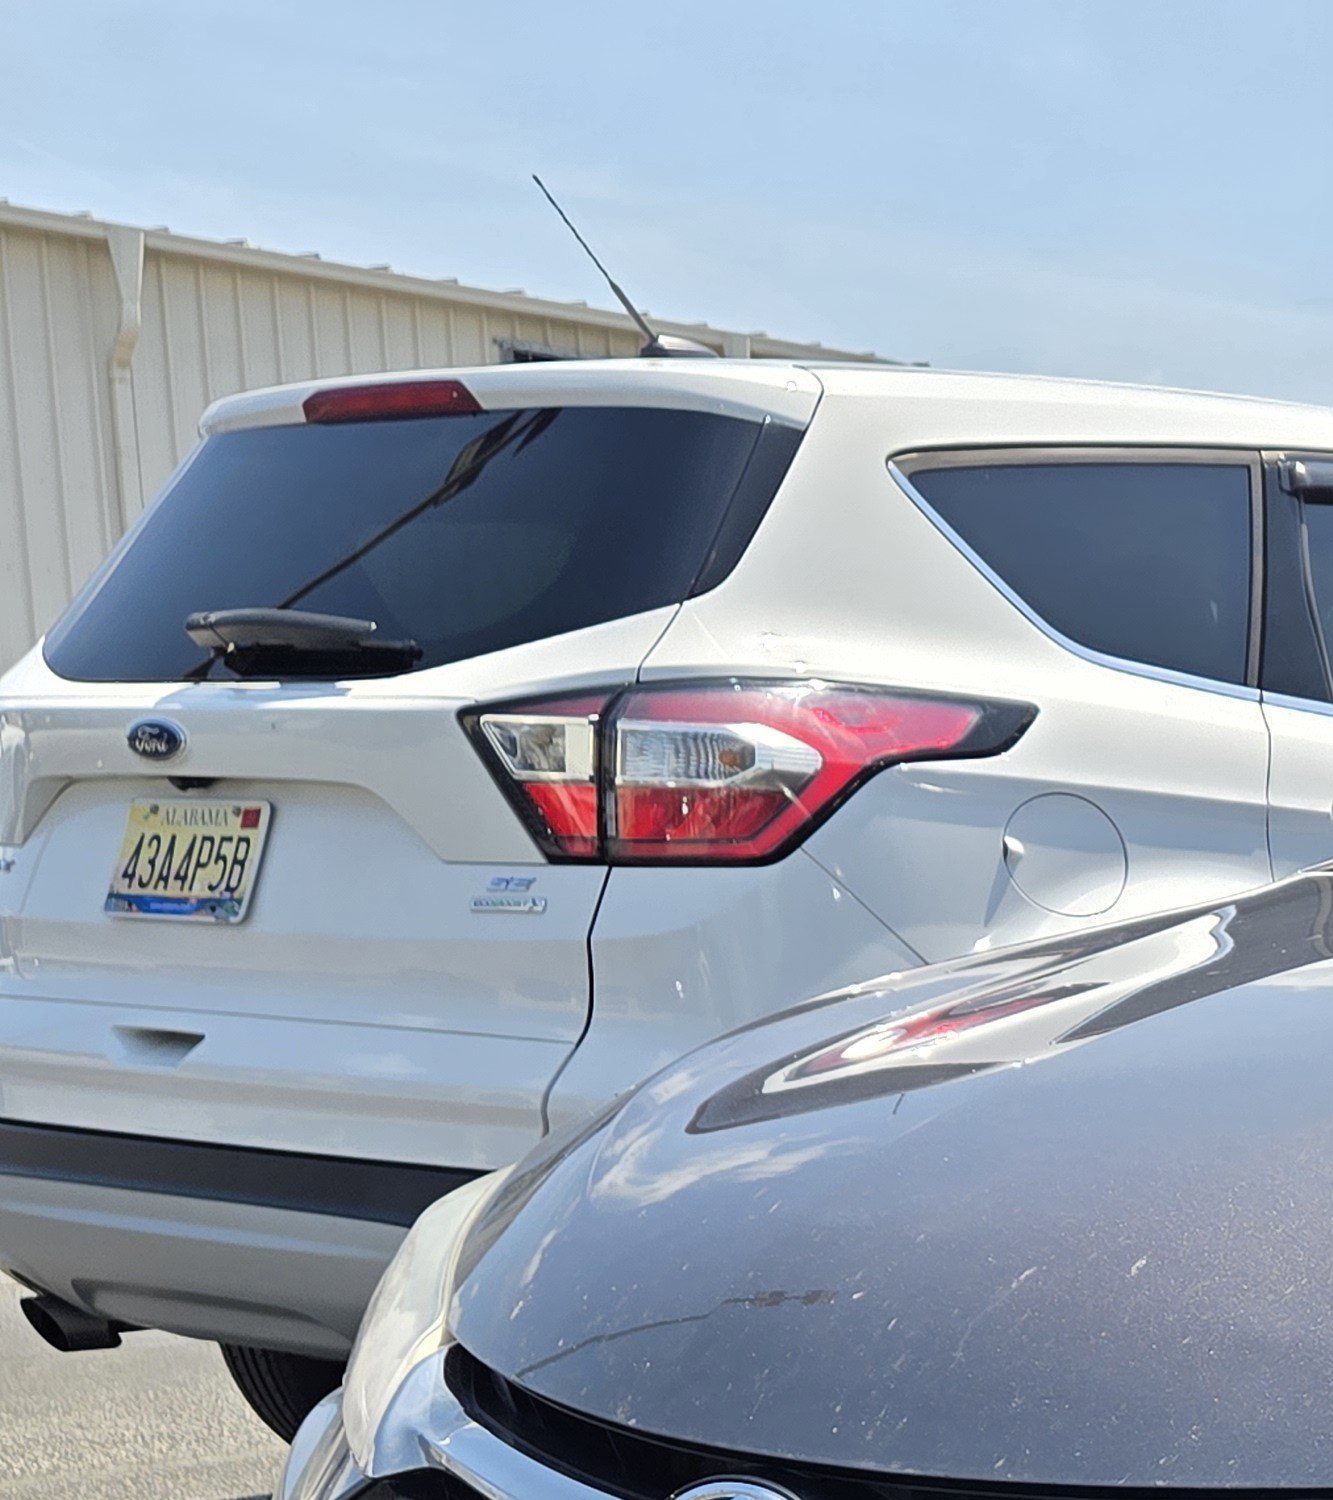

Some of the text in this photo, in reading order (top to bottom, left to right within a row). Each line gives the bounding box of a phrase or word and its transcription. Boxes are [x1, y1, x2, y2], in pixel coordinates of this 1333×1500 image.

[135, 725, 169, 753] Ford
[164, 807, 229, 826] ALABAMA
[121, 832, 251, 893] 43A4P5B
